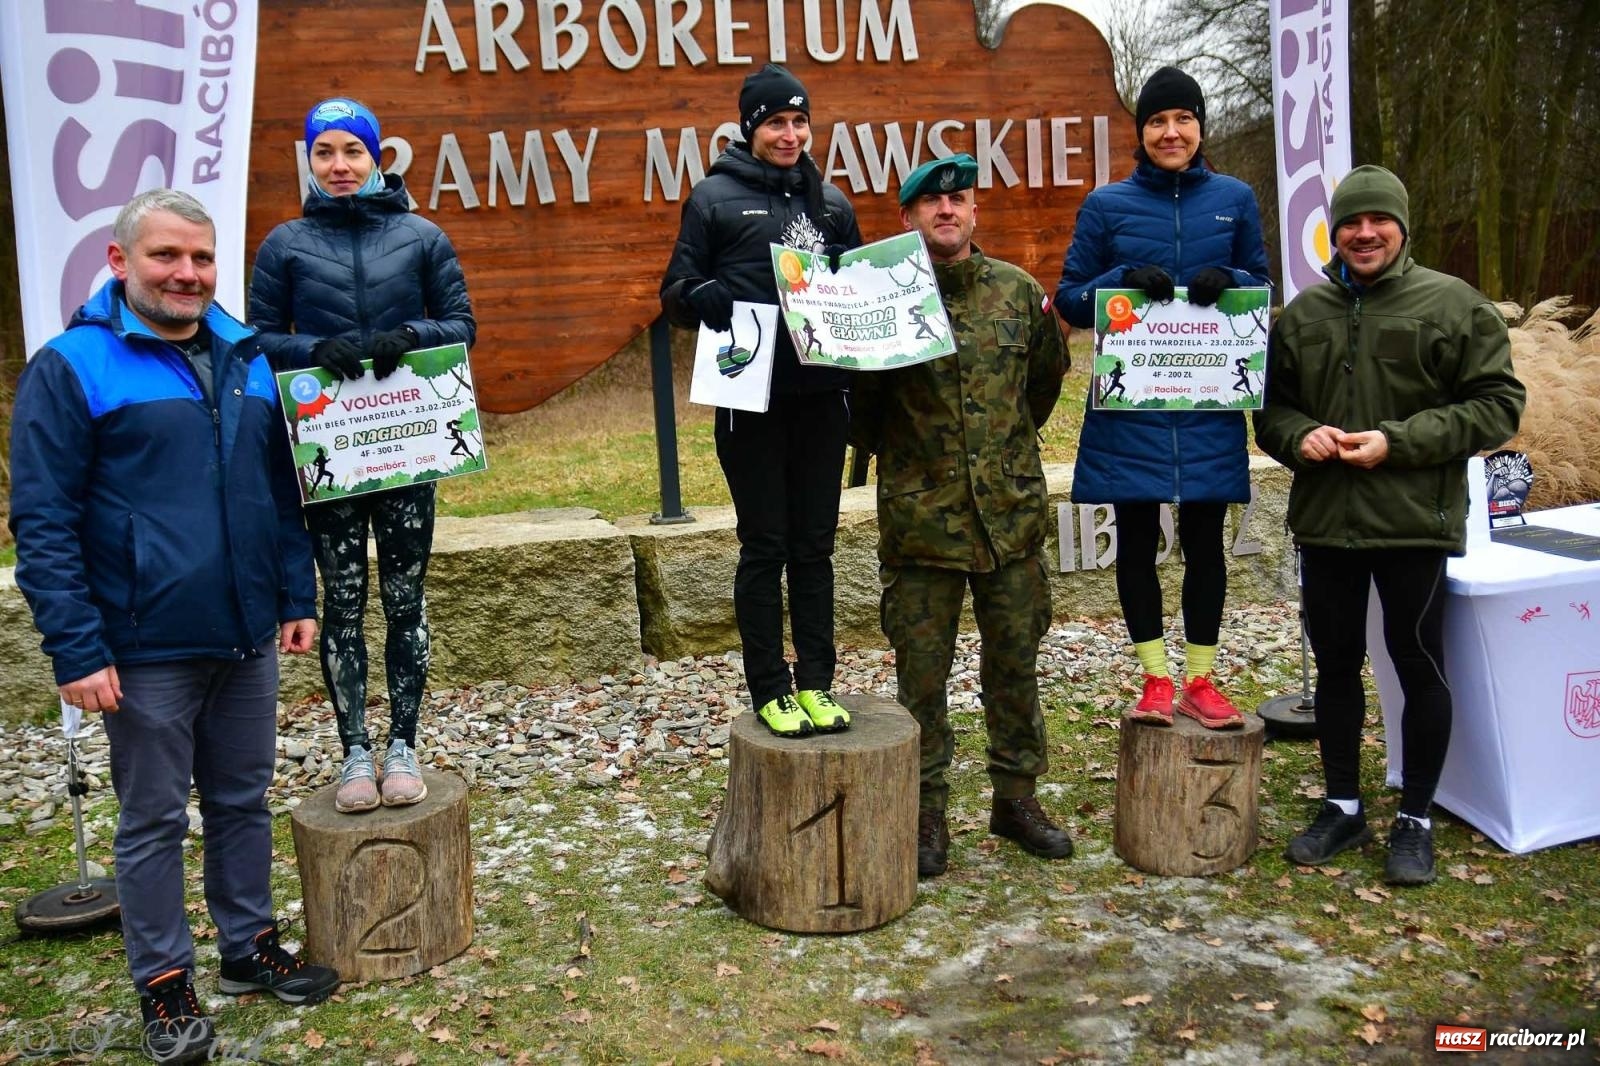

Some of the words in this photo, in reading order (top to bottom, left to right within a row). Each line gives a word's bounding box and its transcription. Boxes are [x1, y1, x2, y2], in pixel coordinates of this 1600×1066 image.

[788, 95, 804, 107] 4F
[295, 128, 599, 210] RAMY
[816, 284, 838, 296] 500
[821, 306, 897, 327] NAGRODA
[1146, 322, 1219, 335] VOUCHER
[1131, 353, 1145, 367] 3
[1148, 353, 1228, 367] NAGRODA
[299, 381, 313, 395] 2
[1154, 385, 1192, 394] Racibórz
[341, 388, 422, 412] VOUCHER
[325, 419, 346, 429] BIEG
[348, 409, 407, 425] TWARDZIELA
[334, 434, 349, 451] 2
[352, 419, 438, 448] NAGRODA
[360, 450, 370, 458] 4F
[377, 446, 393, 456] 300
[366, 460, 407, 474] Racibórz
[415, 455, 437, 466] OSiR
[788, 791, 863, 911] 1
[344, 837, 428, 955] 2
